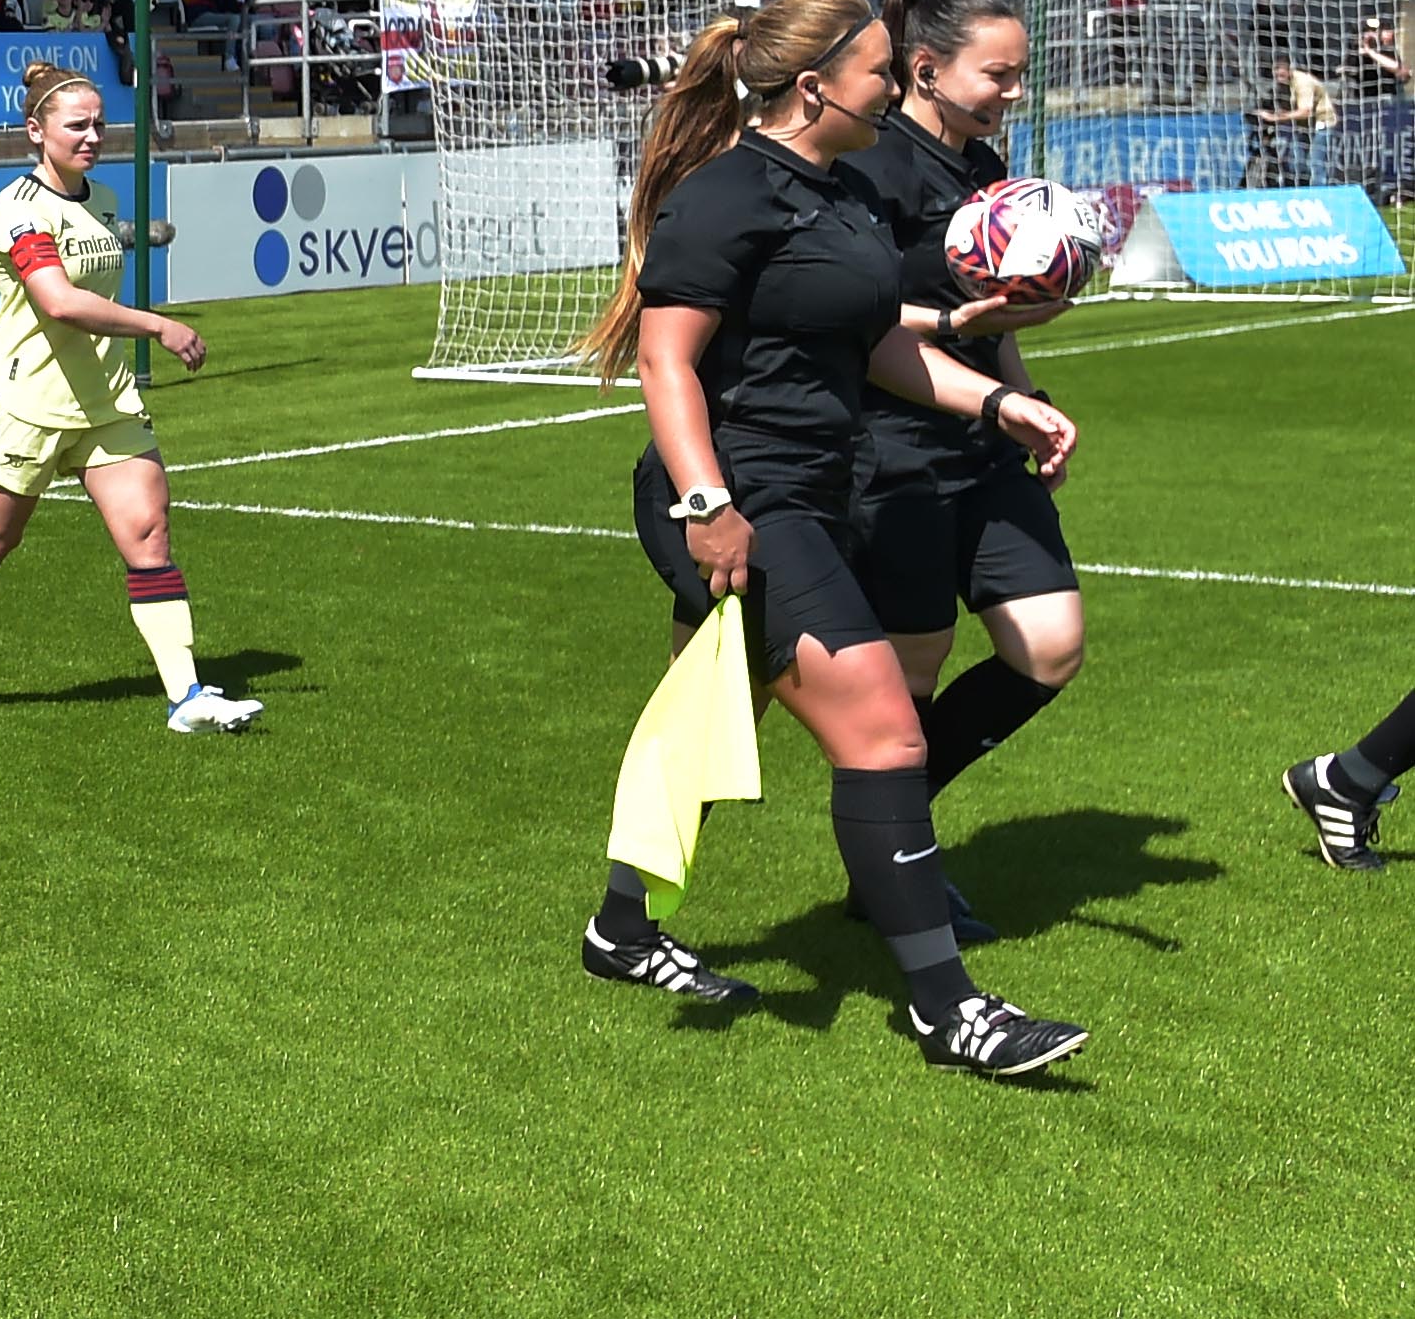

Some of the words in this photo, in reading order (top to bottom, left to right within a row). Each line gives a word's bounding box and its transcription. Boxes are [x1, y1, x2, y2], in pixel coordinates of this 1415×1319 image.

[6, 45, 64, 73] COME
[68, 45, 99, 72] ON
[1, 86, 28, 112] YO
[1209, 201, 1289, 233] COME
[1287, 198, 1333, 228] ON
[1216, 238, 1272, 271] YOU
[1270, 234, 1359, 267] IRONS
